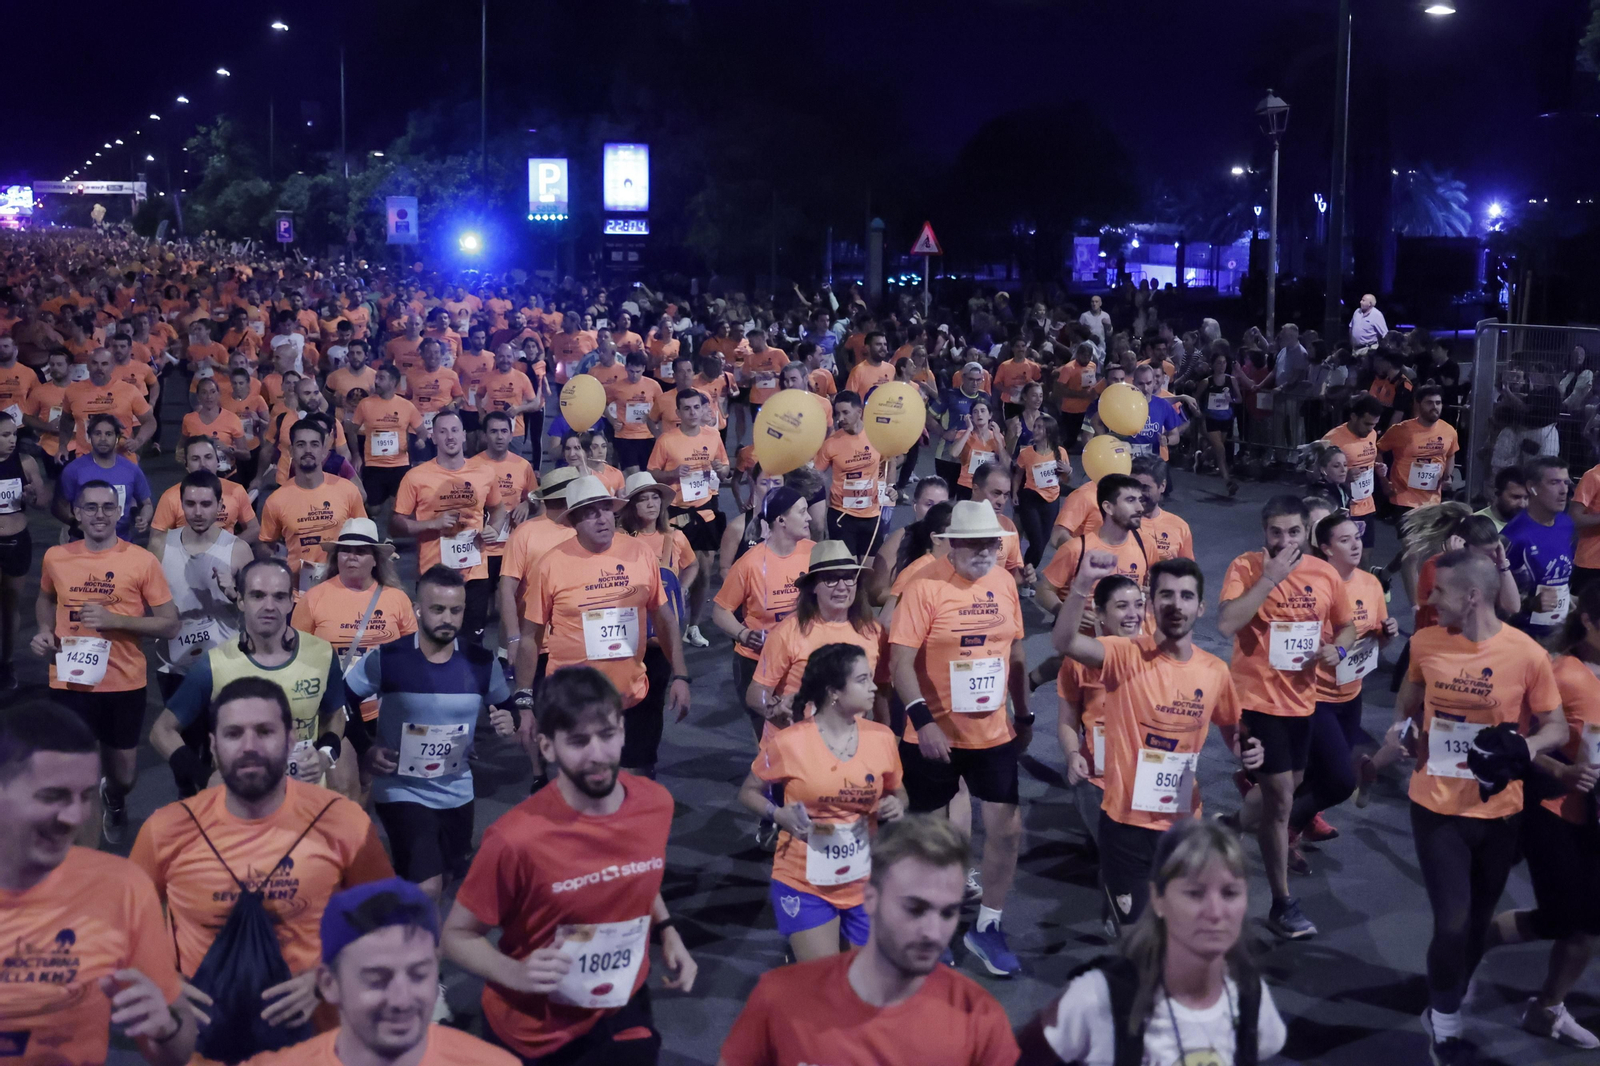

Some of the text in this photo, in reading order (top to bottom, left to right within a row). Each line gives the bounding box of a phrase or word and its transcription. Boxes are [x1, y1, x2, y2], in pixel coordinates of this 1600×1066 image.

[538, 163, 561, 195] P
[536, 203, 558, 213] saba
[280, 221, 289, 233] P
[606, 220, 645, 232] 22:04
[451, 542, 474, 554] 16507
[84, 581, 116, 589] NOCTURNA
[598, 575, 629, 583] NOCTURNA
[69, 586, 114, 595] SEVILLA KH7
[585, 582, 614, 591] SEVILLA
[600, 624, 627, 638] 3771
[178, 630, 210, 647] 14258
[1284, 638, 1314, 651] 17439
[66, 651, 99, 667] 14259
[969, 676, 995, 690] 3777
[1434, 681, 1492, 697] SEVILLA KH7
[1452, 678, 1494, 689] NOCTURNA
[1155, 704, 1203, 718] SEVILLA KH7
[1172, 700, 1205, 709] NOCTURNA
[420, 743, 452, 756] 7329
[552, 857, 664, 894] sopra steria
[578, 949, 631, 973] 18029
